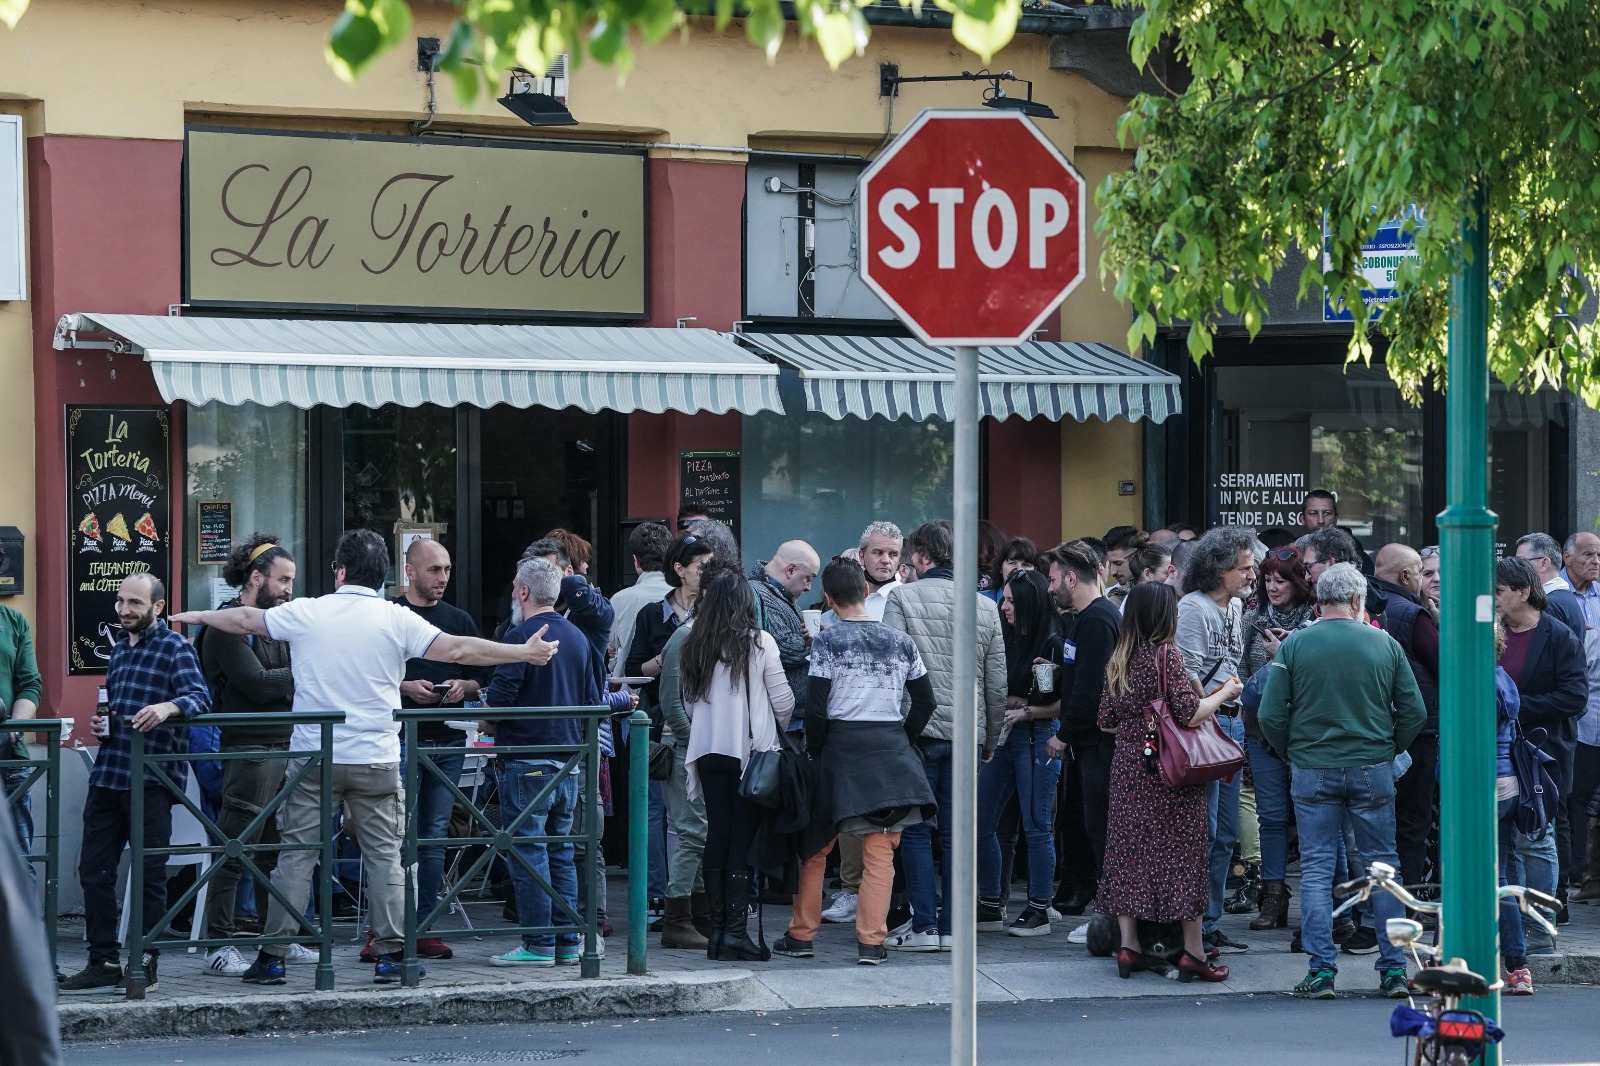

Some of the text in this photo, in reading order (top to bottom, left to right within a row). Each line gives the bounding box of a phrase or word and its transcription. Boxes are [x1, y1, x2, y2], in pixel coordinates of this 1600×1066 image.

[210, 163, 626, 280] La Torteria
[878, 188, 1070, 269] STOP
[1358, 255, 1403, 269] COBONUS
[105, 414, 128, 443] La
[80, 444, 150, 474] Torteria
[687, 460, 712, 473] PIZZA
[1220, 473, 1304, 488] SERRAMENTI
[82, 482, 117, 511] PIZZA
[1220, 490, 1232, 505] IN
[1235, 490, 1259, 505] PVC
[1262, 491, 1270, 505] E
[1220, 511, 1262, 526] TENDE
[1266, 511, 1285, 526] DA
[83, 537, 97, 546] Pizza
[112, 537, 127, 546] Pizza
[139, 537, 153, 546] Pizza
[88, 560, 151, 576] ITALIAN FOOD
[79, 577, 123, 592] and COFFE
